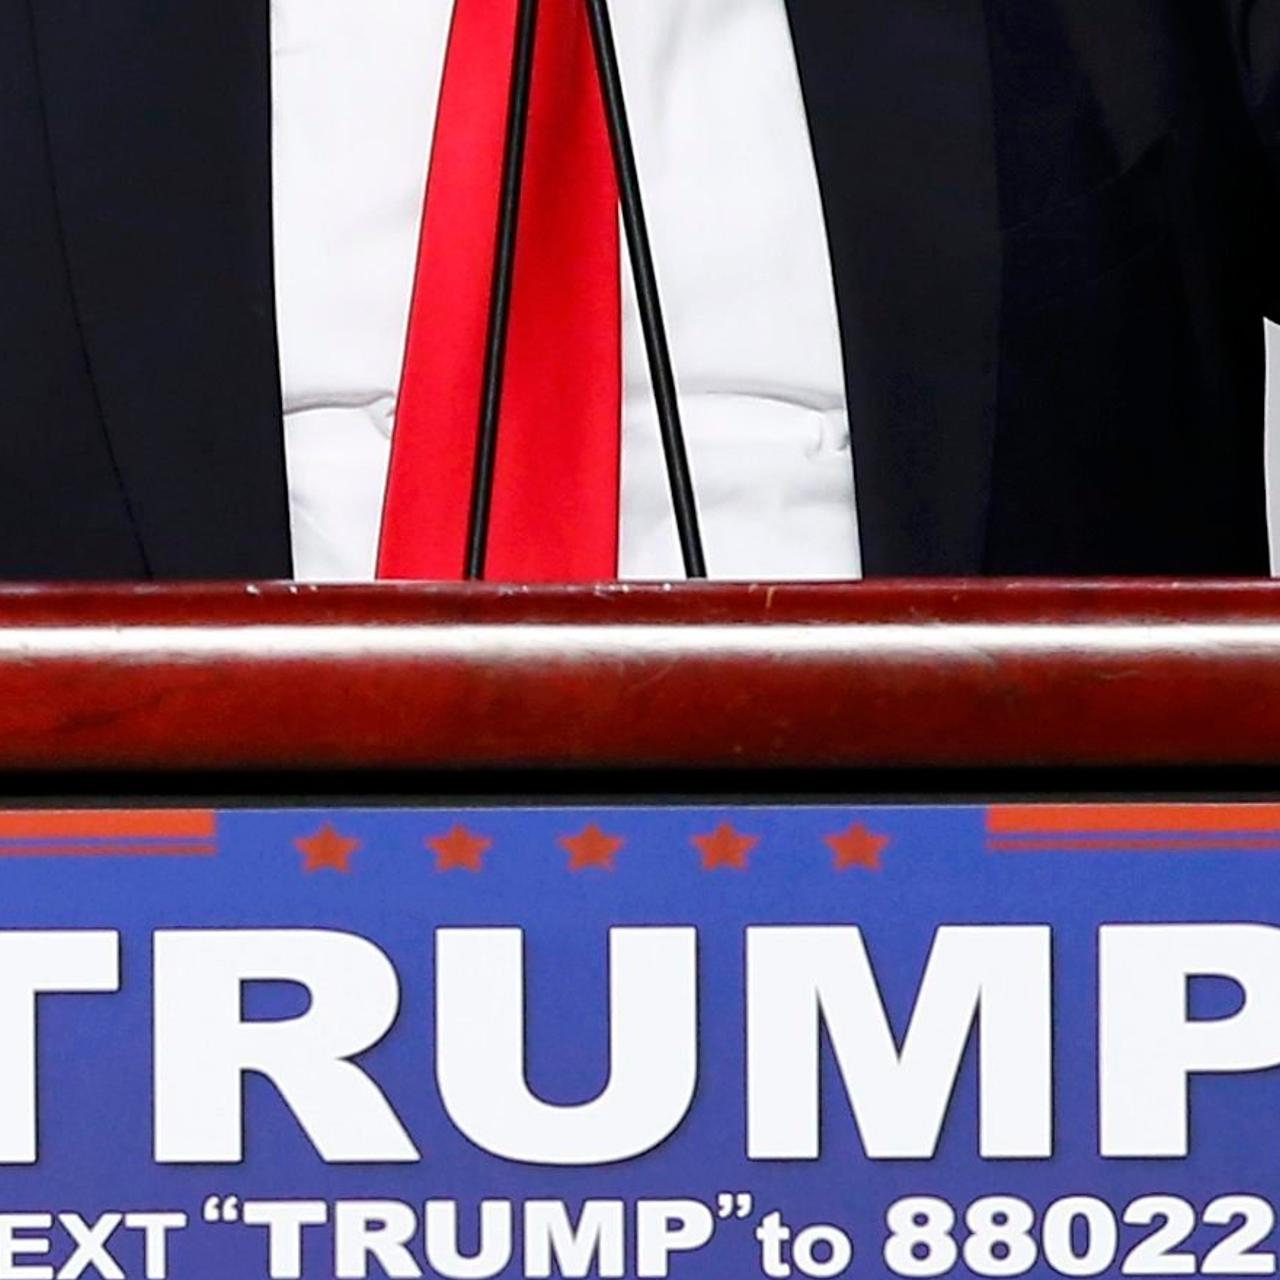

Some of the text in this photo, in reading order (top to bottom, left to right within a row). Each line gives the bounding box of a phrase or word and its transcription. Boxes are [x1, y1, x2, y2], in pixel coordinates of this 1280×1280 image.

[204, 1194, 752, 1280] “TRUMP”
[756, 1212, 852, 1278] to
[884, 1195, 1277, 1277] 88022
